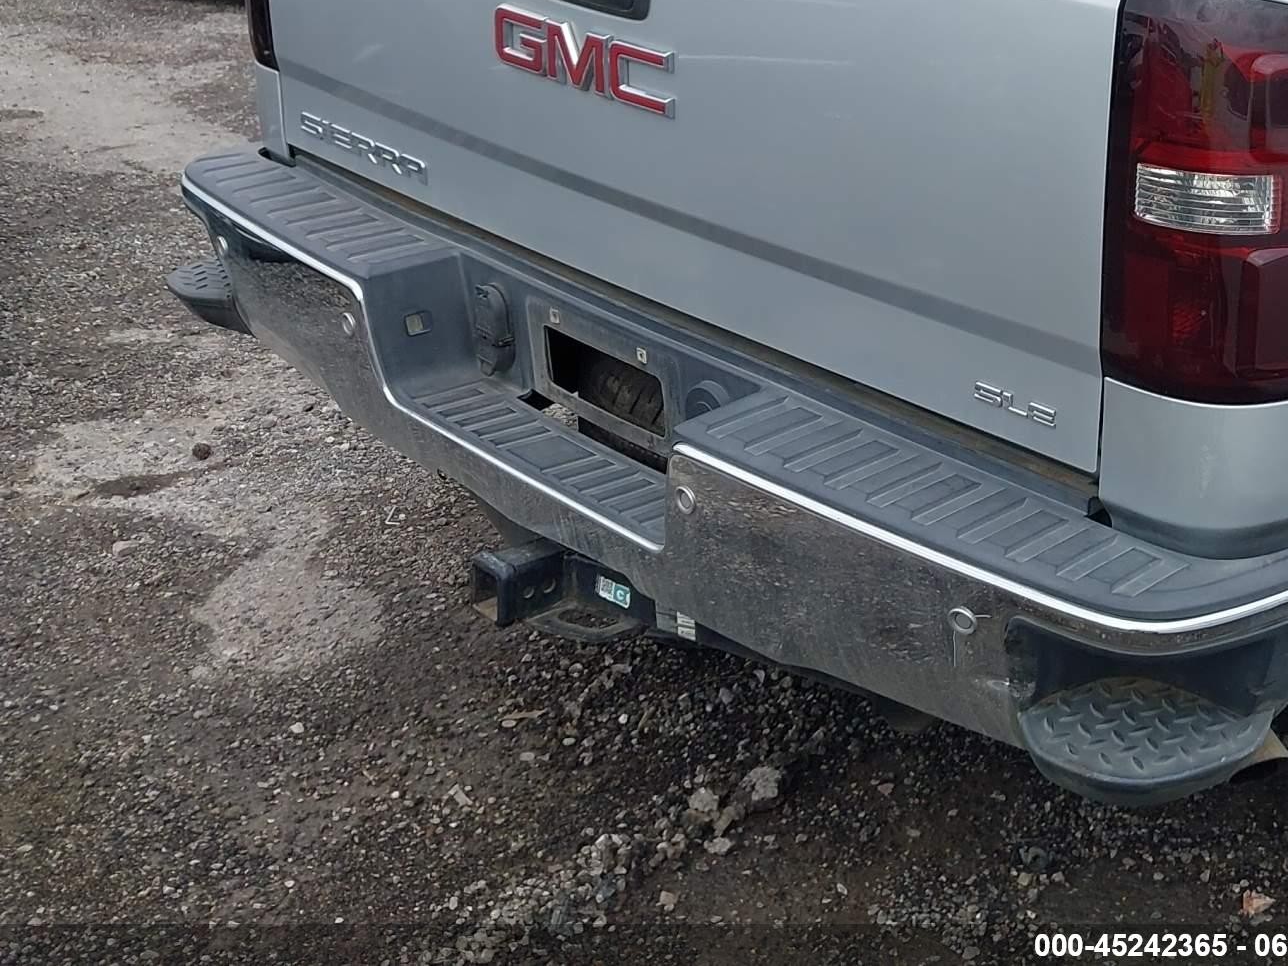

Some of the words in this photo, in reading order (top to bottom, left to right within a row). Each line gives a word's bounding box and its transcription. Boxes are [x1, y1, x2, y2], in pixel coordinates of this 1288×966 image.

[495, 3, 676, 120] GMC
[300, 111, 428, 186] SIERRA
[974, 381, 1056, 428] SLE
